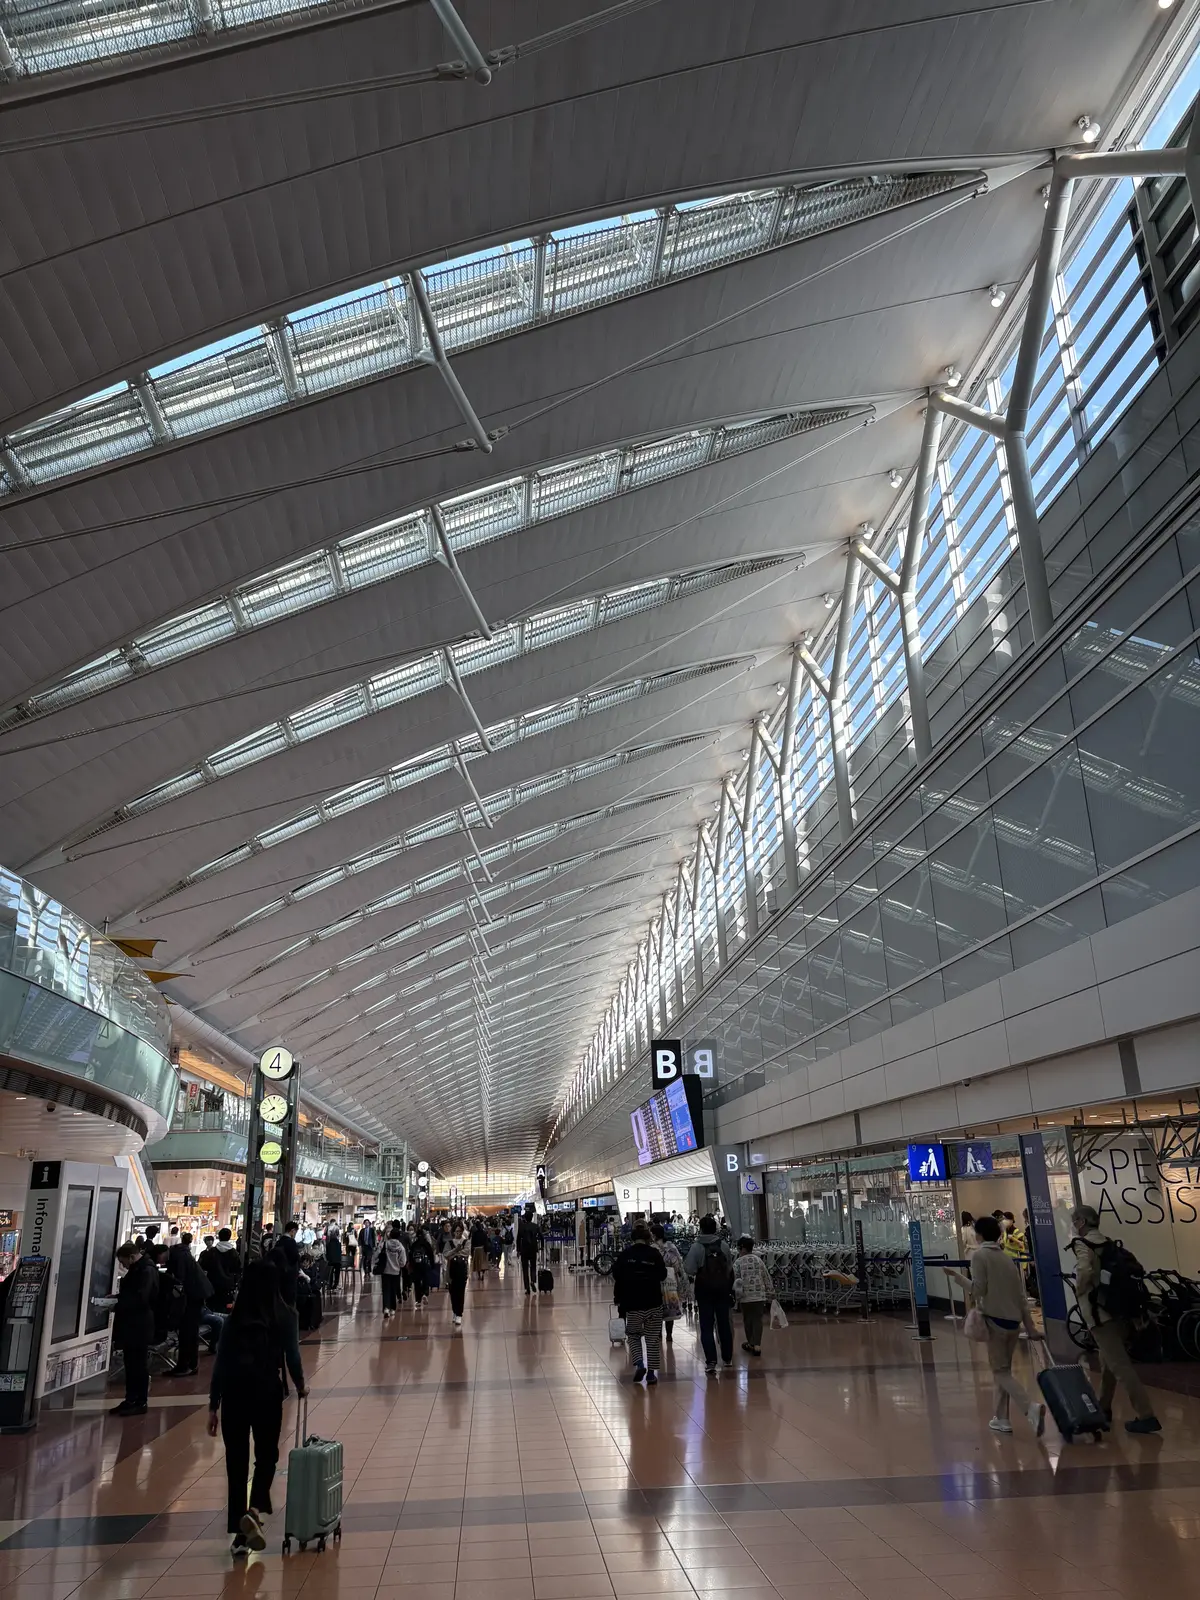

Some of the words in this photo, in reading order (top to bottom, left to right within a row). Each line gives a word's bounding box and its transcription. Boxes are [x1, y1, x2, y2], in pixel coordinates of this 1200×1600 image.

[269, 1052, 282, 1073] 4
[656, 1050, 677, 1078] B
[911, 1144, 917, 1153] 9
[537, 1167, 546, 1177] A
[726, 1154, 739, 1172] B
[1087, 1148, 1200, 1185] SPECI
[623, 1189, 631, 1200] B
[1098, 1186, 1200, 1225] ASSIS
[913, 1244, 925, 1288] ENTRANCE
